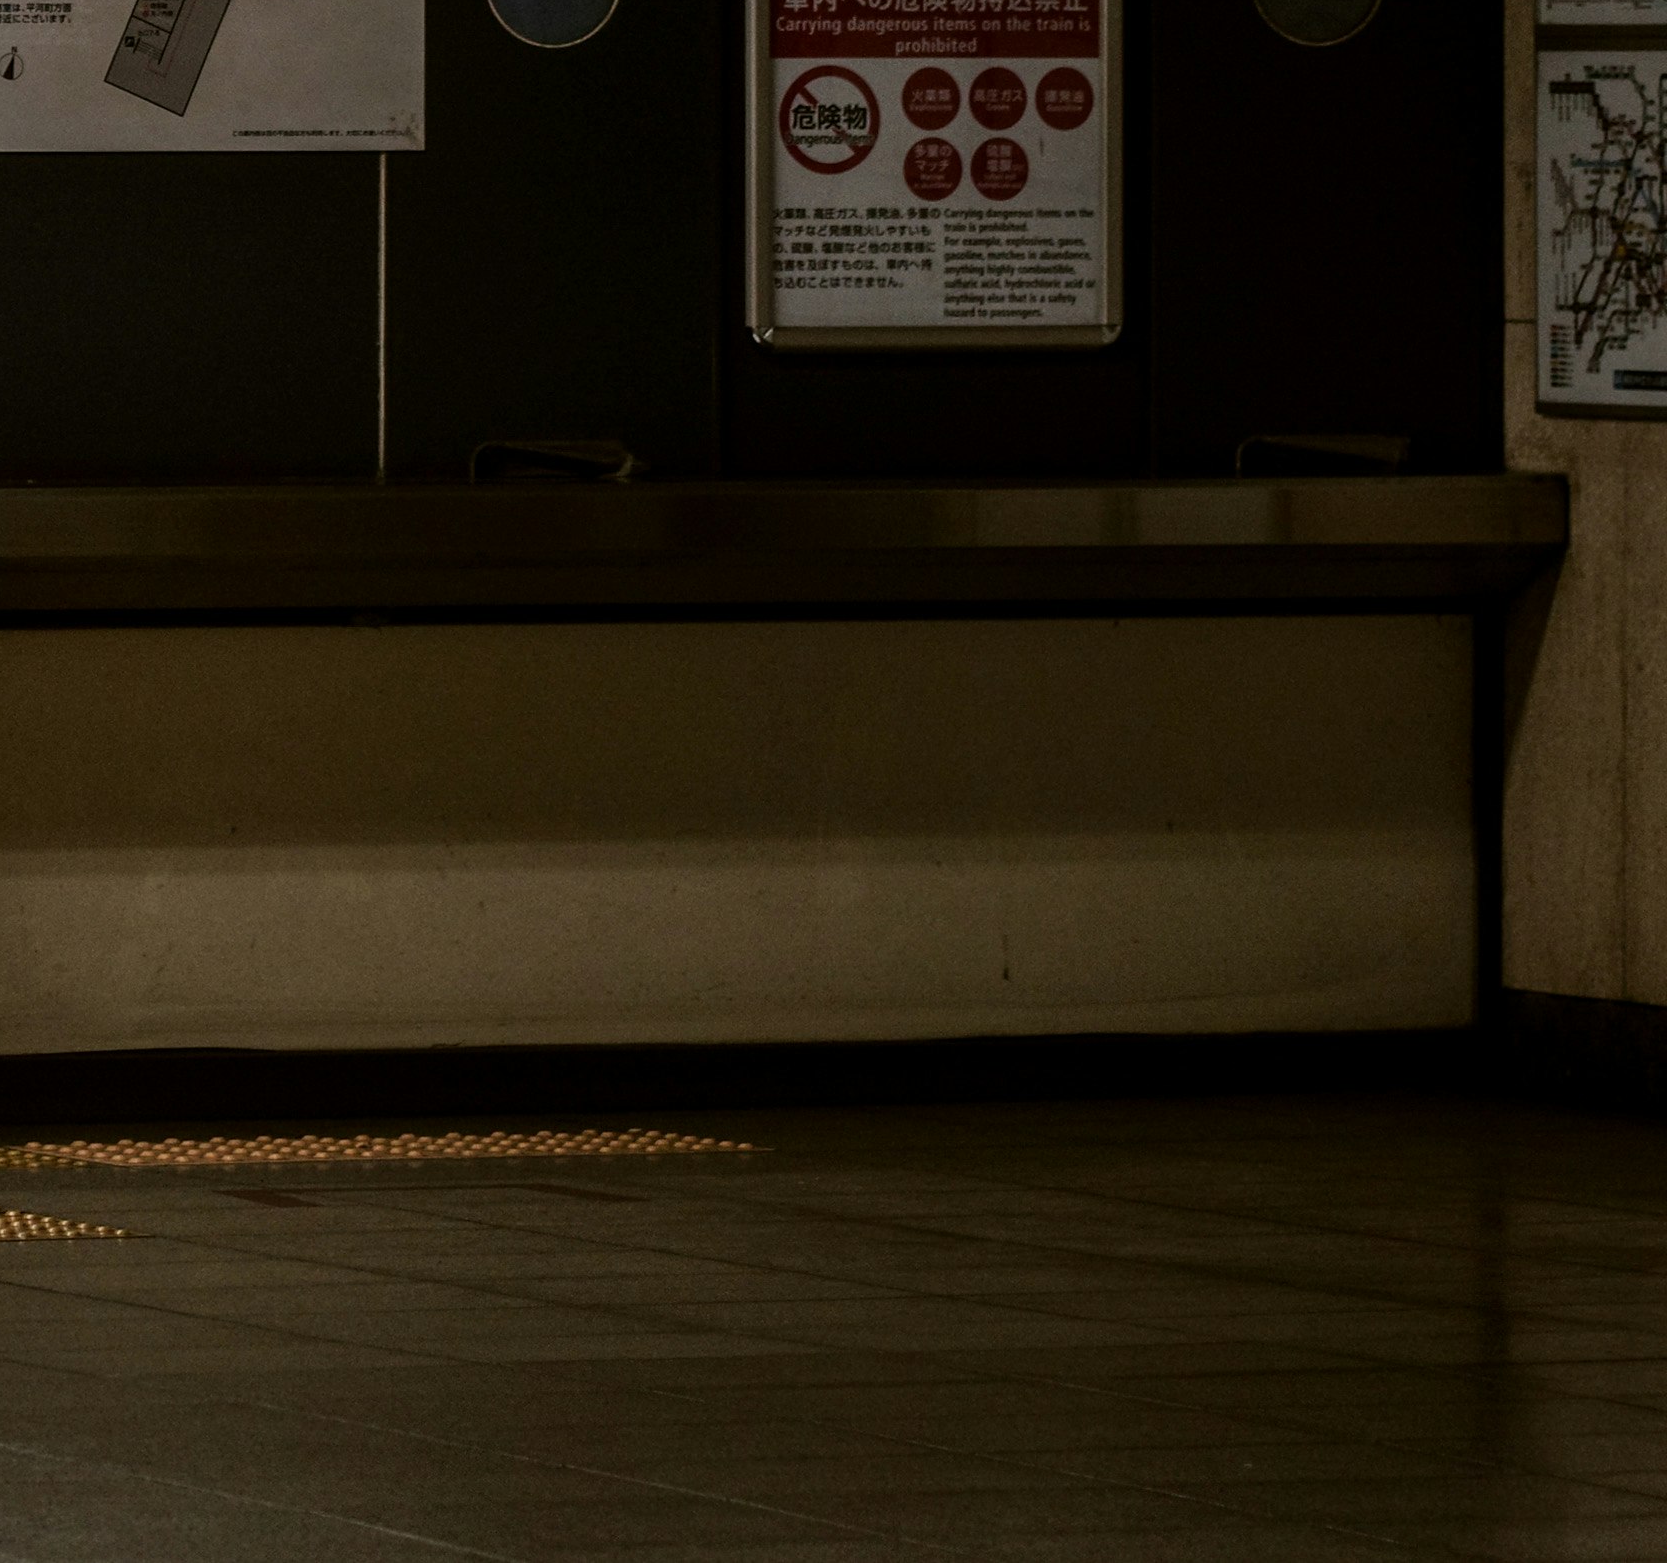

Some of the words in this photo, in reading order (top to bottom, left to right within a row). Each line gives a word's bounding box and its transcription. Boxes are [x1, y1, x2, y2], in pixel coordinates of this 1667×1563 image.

[775, 17, 843, 36] Carrying
[847, 17, 927, 36] dangerous
[933, 17, 977, 32] items
[981, 20, 1001, 32] on
[1006, 17, 1031, 32] the
[1036, 17, 1074, 32] train
[1079, 17, 1091, 32] is
[895, 38, 978, 55] prohibited
[973, 89, 1024, 102] 高圧ガス
[791, 104, 868, 130] 危険物
